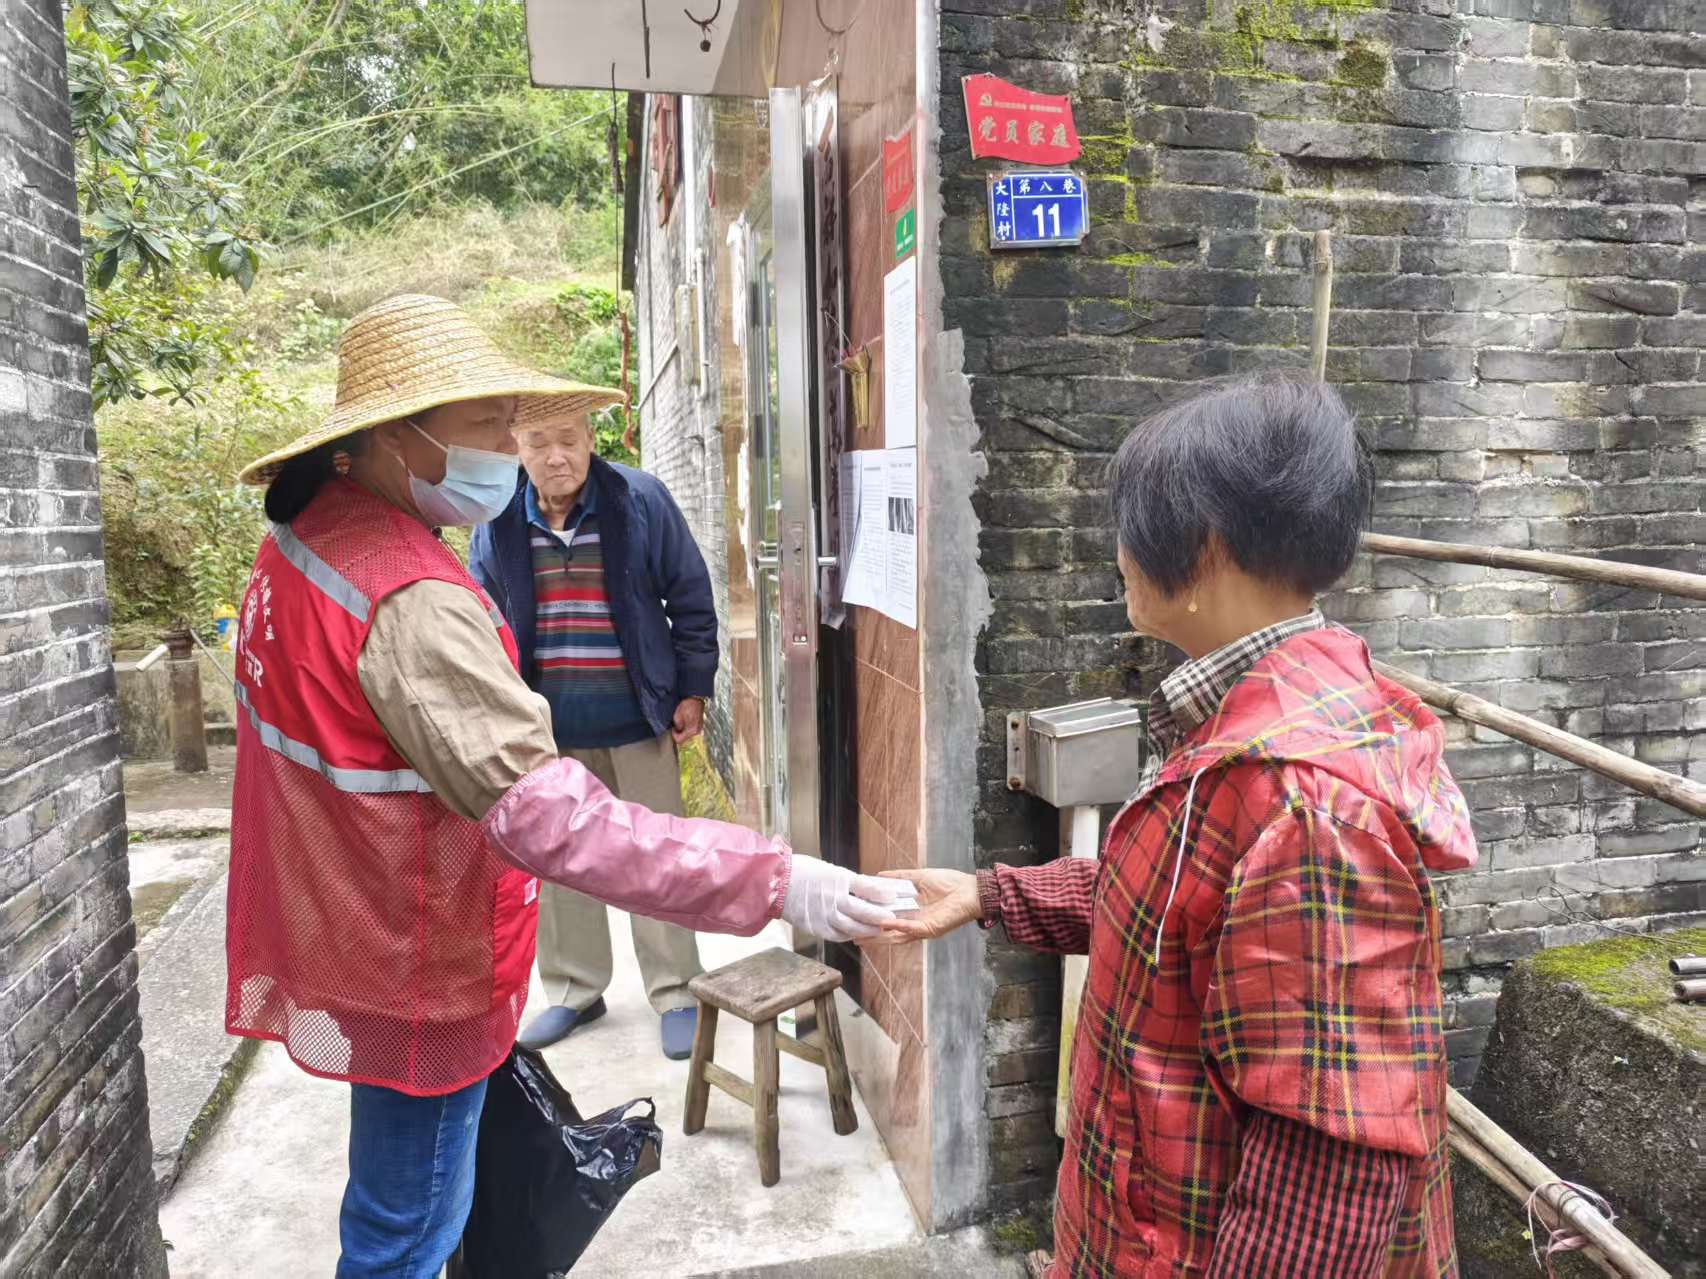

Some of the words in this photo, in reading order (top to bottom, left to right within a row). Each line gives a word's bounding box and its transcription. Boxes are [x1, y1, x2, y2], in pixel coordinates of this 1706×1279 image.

[978, 115, 1072, 148] 党员家庭
[1018, 178, 1077, 195] 第八巷
[1032, 203, 1062, 237] 11
